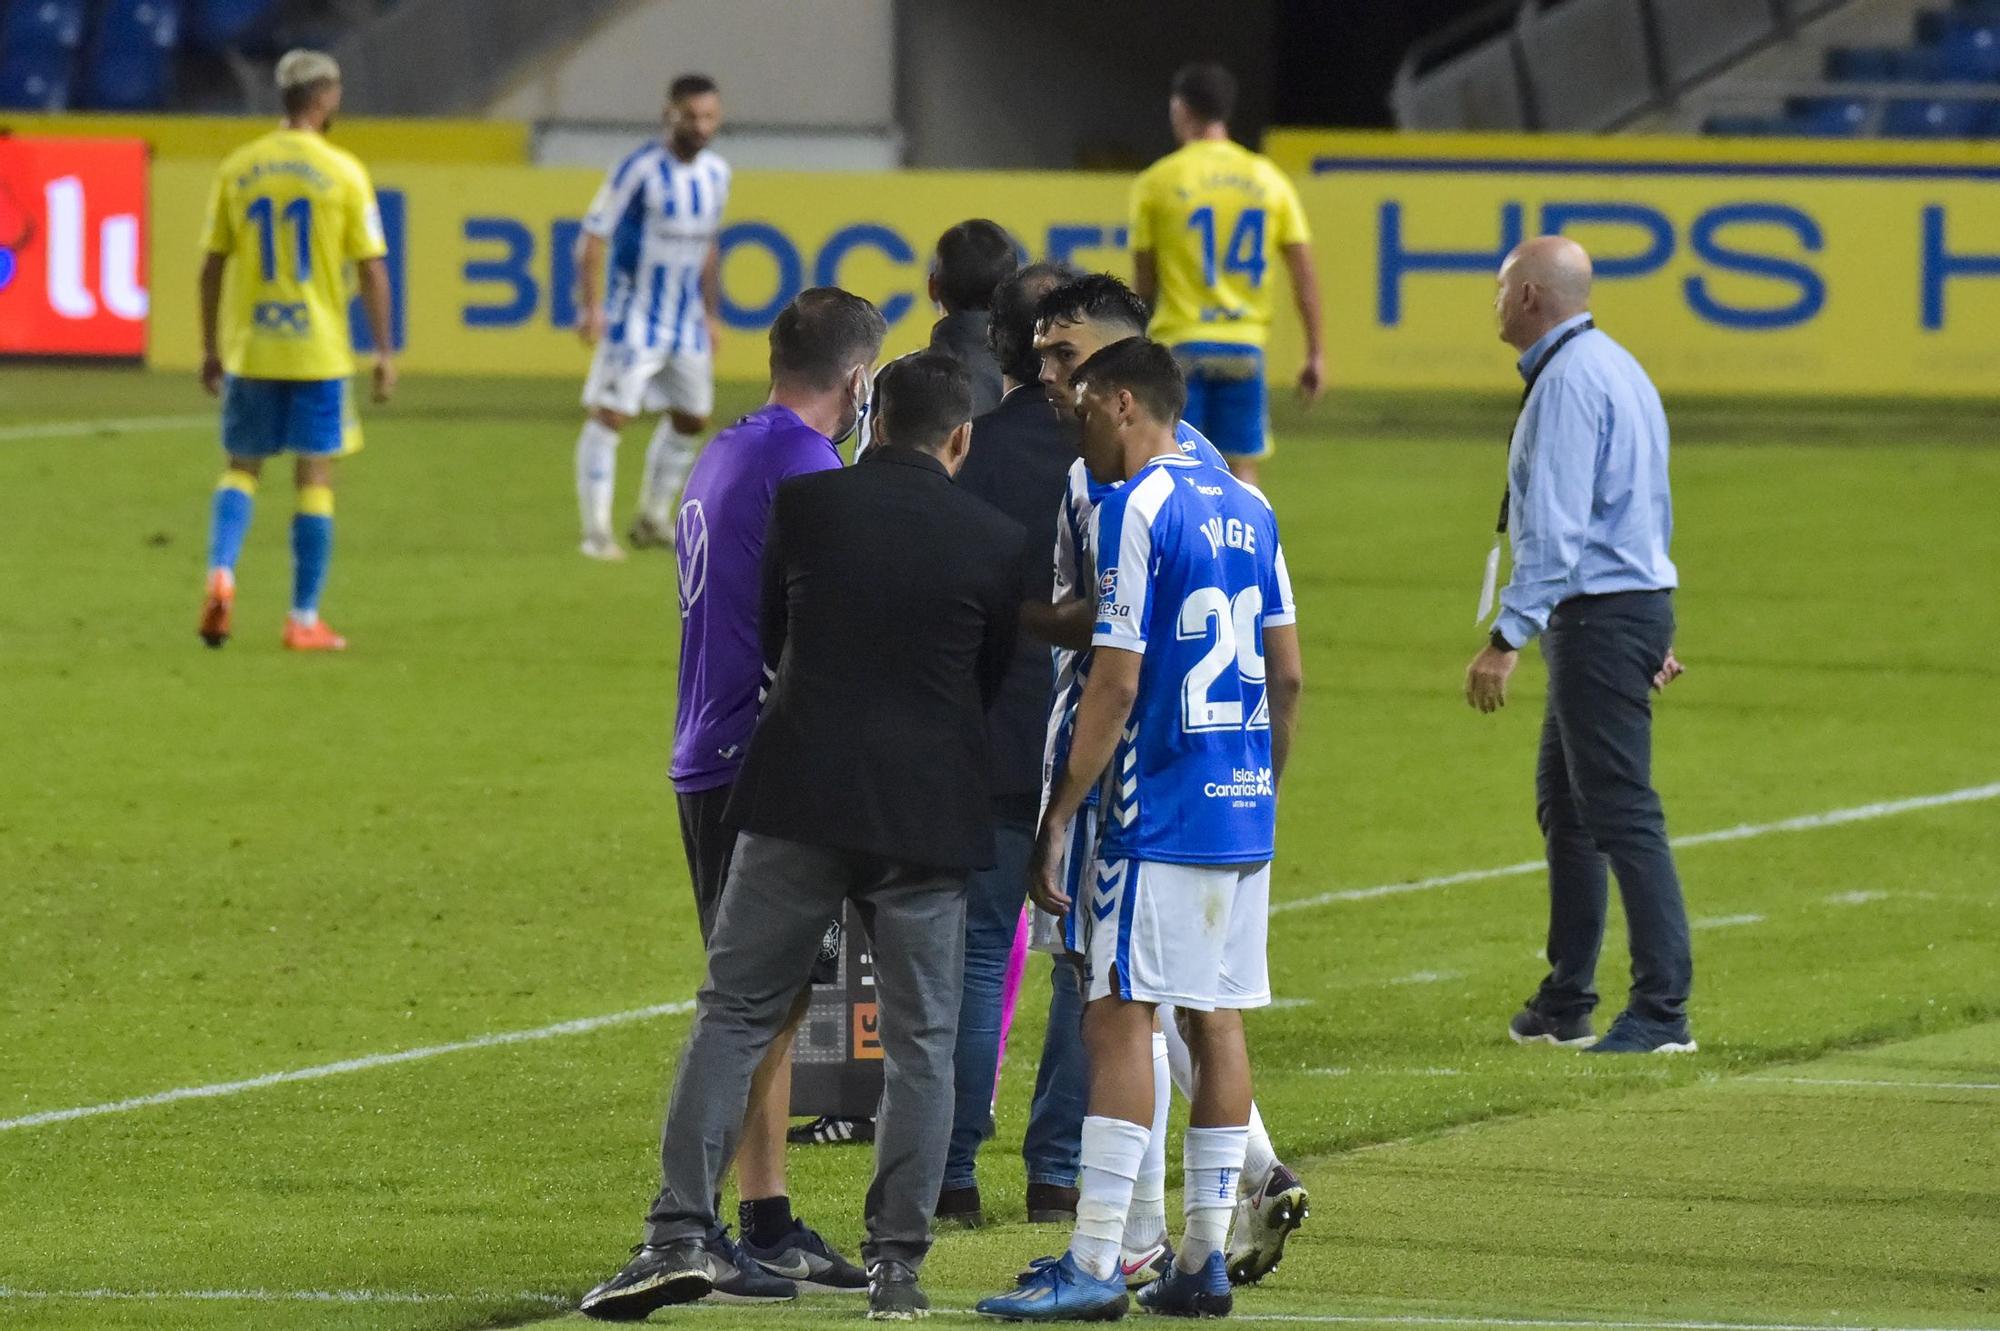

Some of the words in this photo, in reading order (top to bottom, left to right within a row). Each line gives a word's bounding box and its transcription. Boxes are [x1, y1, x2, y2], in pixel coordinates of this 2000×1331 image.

[247, 197, 312, 282] 11
[1187, 206, 1268, 289] 14
[1378, 201, 1828, 331] HPS
[1204, 782, 1257, 797] Canarias
[1232, 767, 1256, 784] Islas
